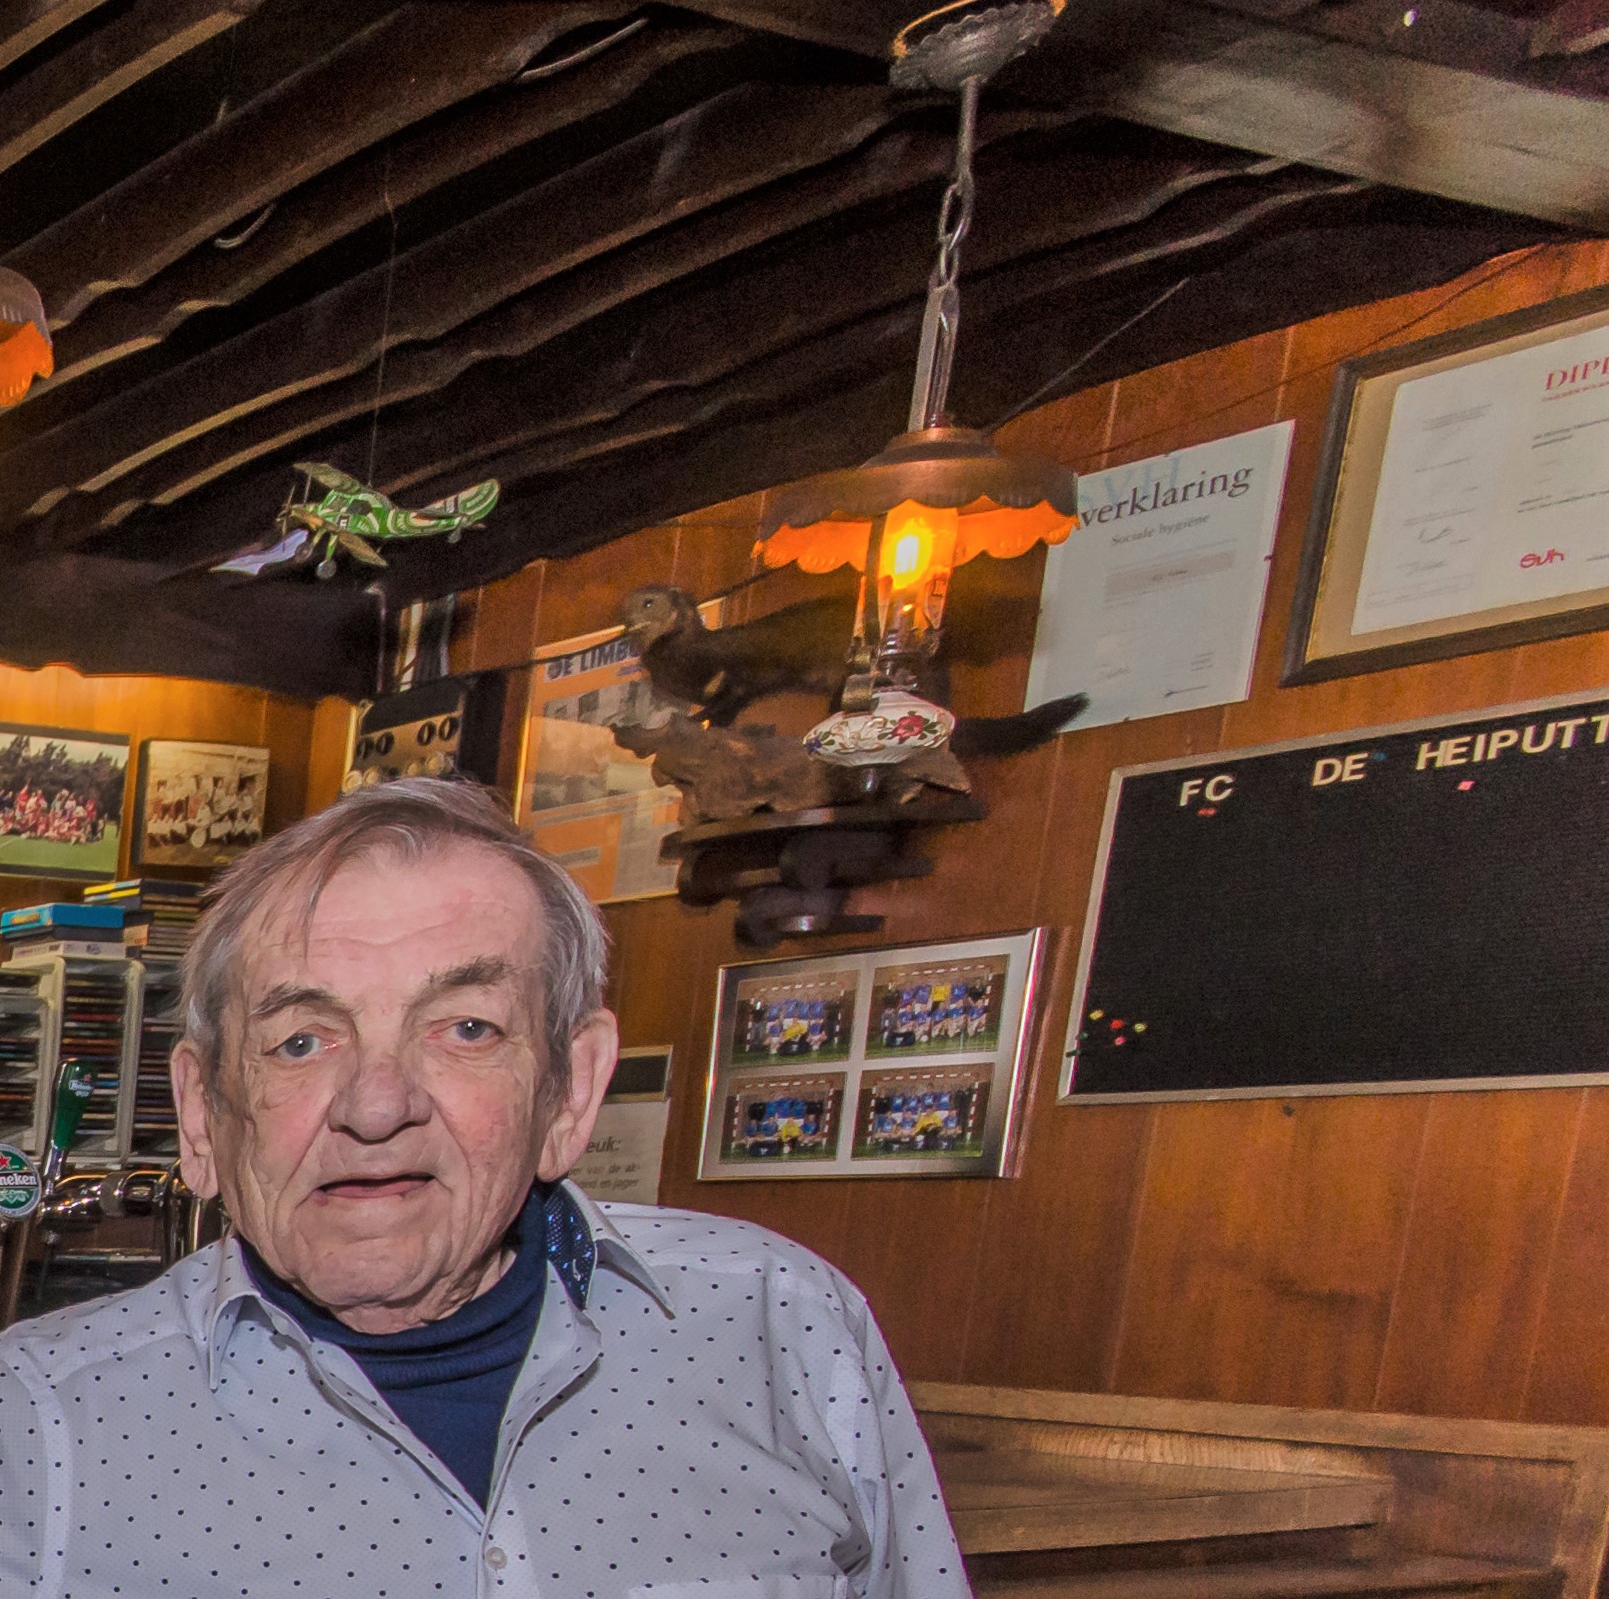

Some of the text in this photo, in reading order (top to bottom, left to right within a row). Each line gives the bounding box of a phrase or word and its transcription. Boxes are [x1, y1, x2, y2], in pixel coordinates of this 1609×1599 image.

[1081, 467, 1255, 528] verklaring
[1179, 775, 1236, 807] FC
[1311, 752, 1369, 787] DE
